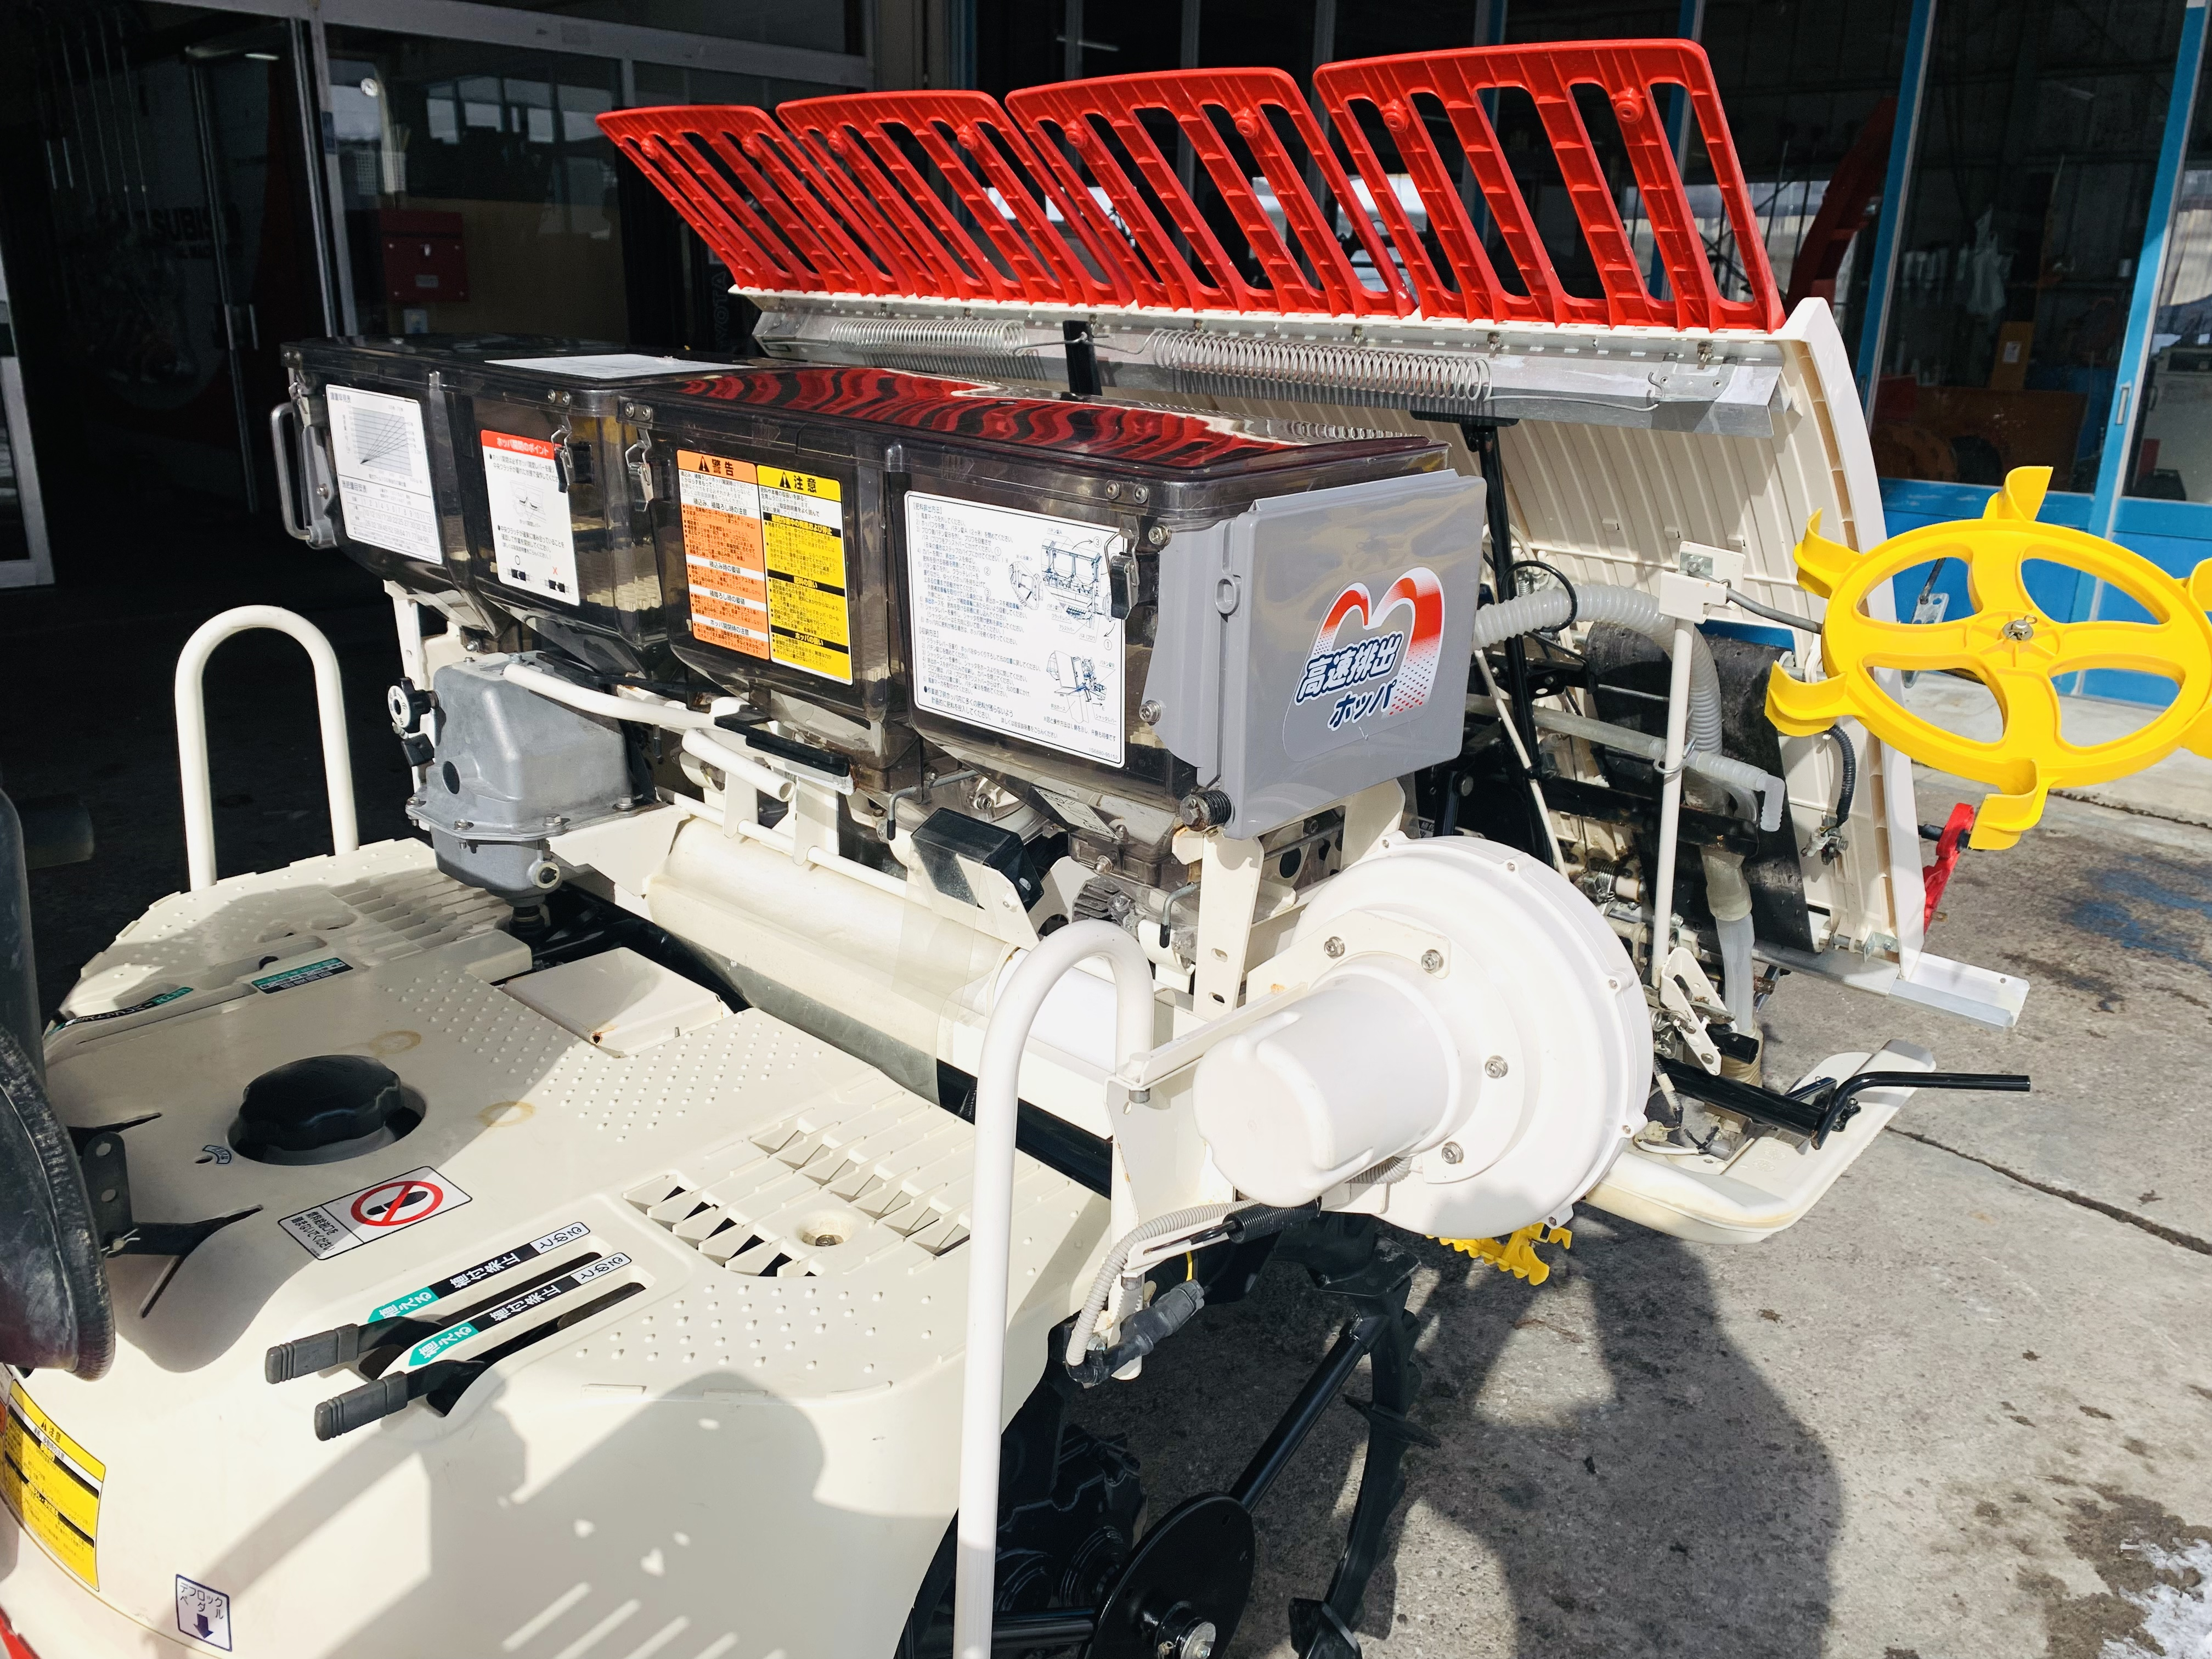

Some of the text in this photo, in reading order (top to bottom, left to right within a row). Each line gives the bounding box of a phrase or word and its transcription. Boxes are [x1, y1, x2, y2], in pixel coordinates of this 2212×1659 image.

[496, 436, 549, 456] ホッパ開閉のポイント
[711, 458, 733, 477] 警告
[793, 475, 816, 493] 注意
[709, 560, 740, 574] 積込み時の要領
[709, 590, 745, 605] 積降ろし時の要領
[710, 619, 749, 636] ホッパ開閉時の注意
[1295, 633, 1403, 704] 高速排出
[1328, 679, 1398, 730] ホッパ
[379, 1227, 582, 1318] 植える 植付条止 とめる
[418, 1257, 623, 1359] 植える 植付条止 とめる
[180, 1582, 223, 1607] デフロック
[180, 1595, 224, 1620] ペダル
